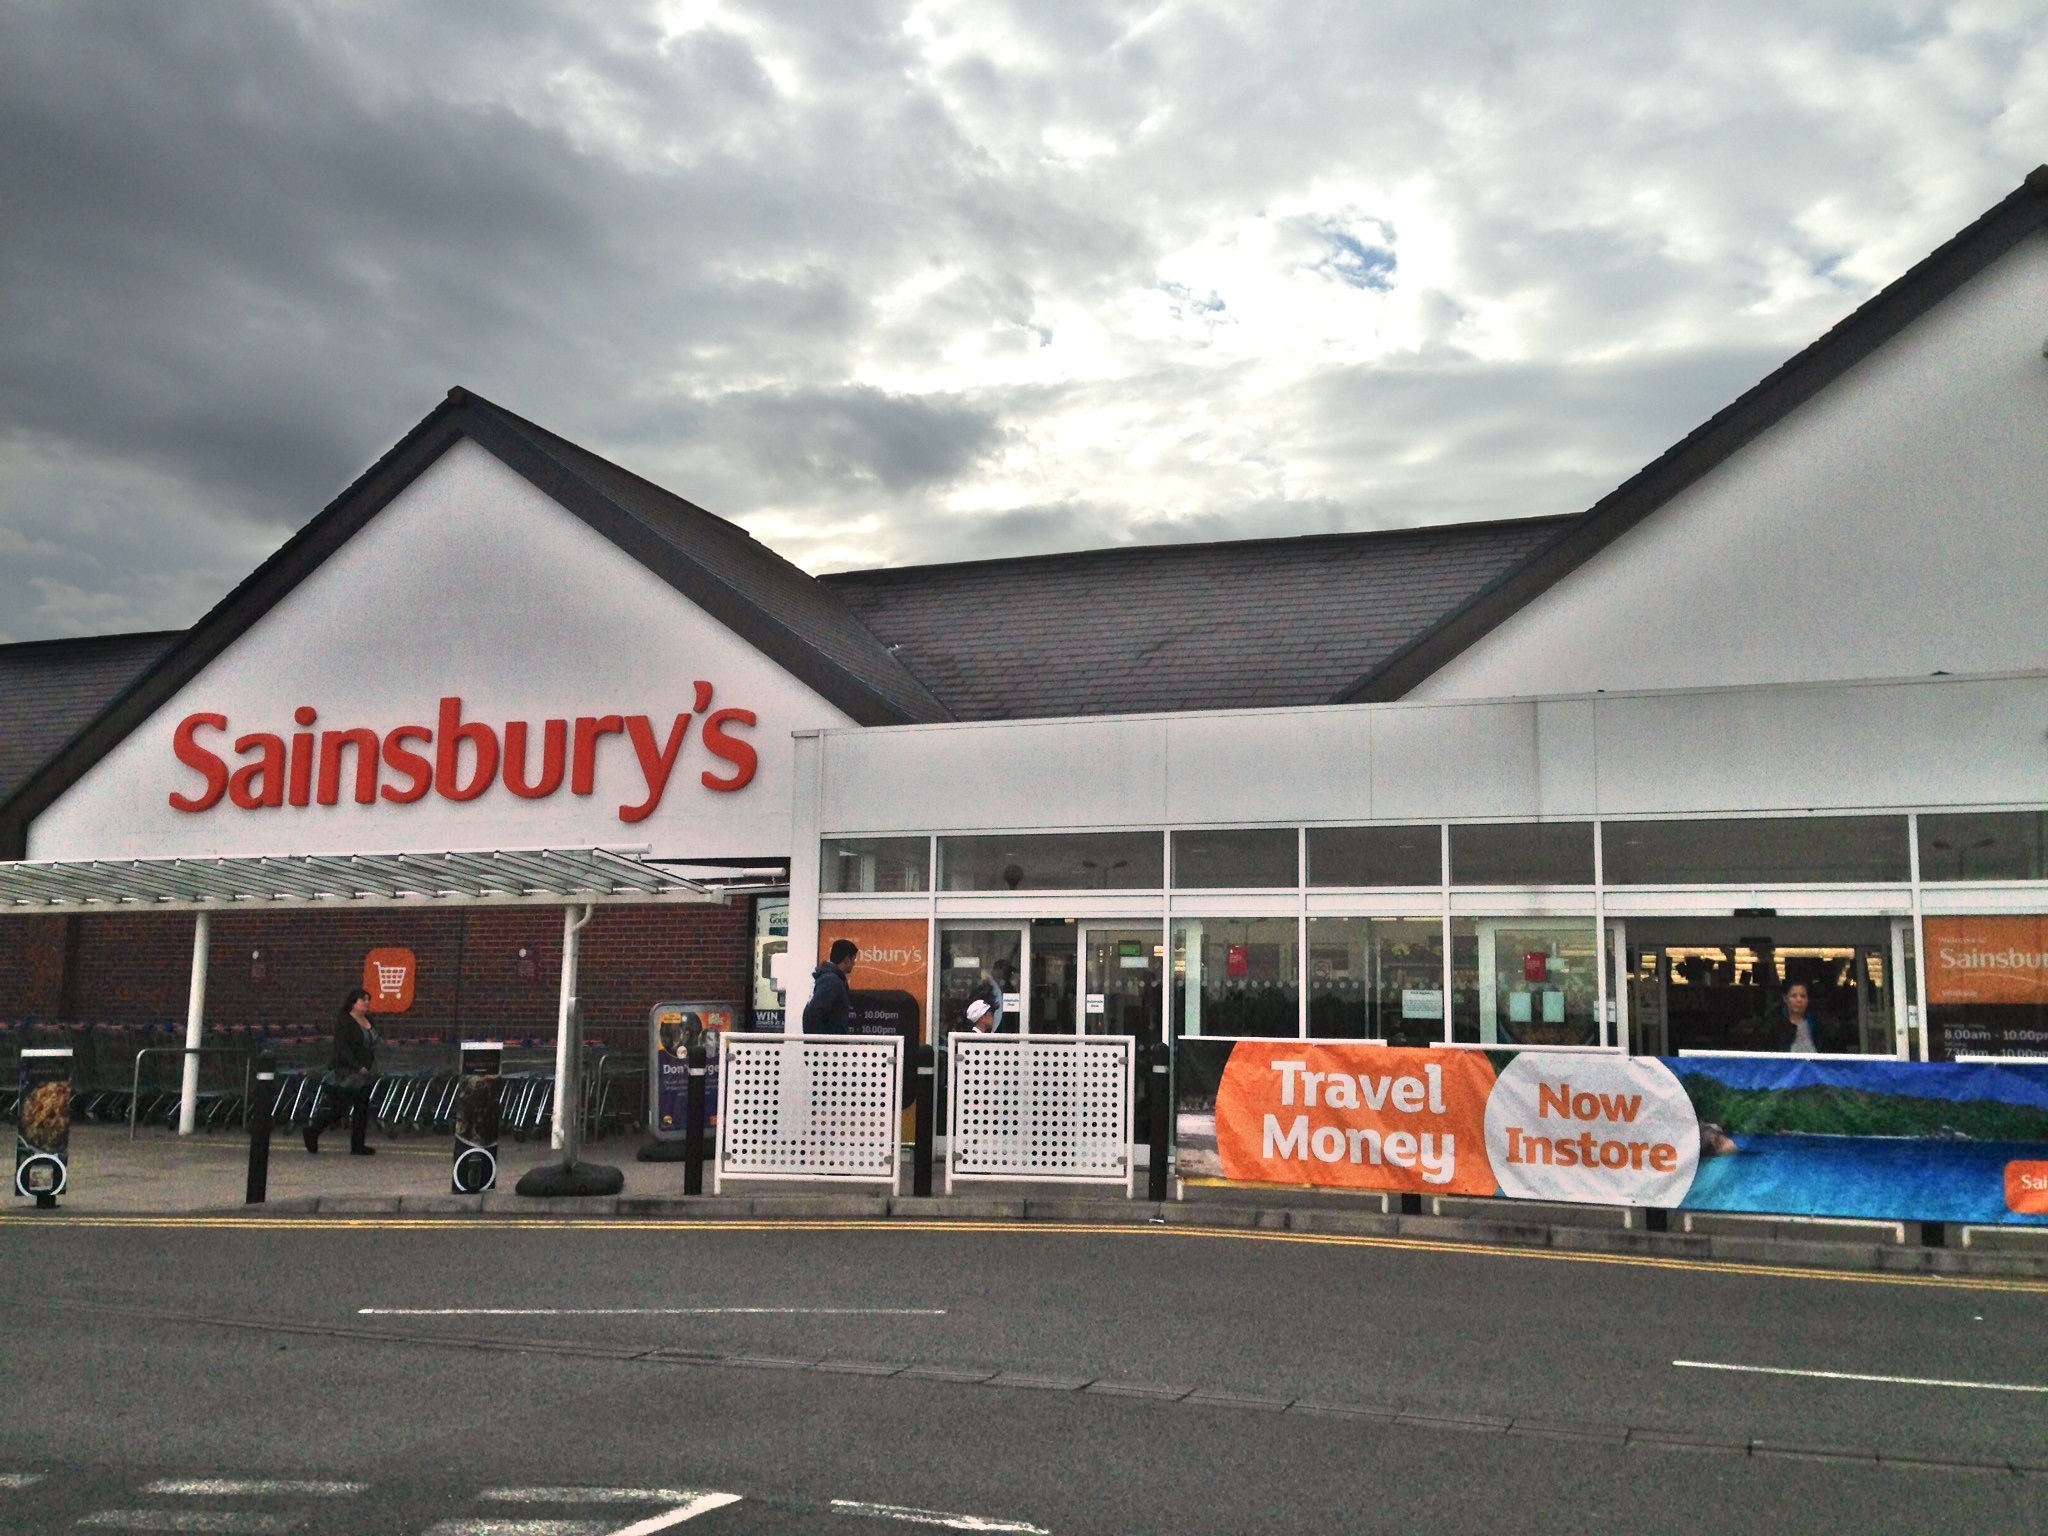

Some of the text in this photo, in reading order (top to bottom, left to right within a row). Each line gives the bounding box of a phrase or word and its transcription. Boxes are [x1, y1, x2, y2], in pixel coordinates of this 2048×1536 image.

[169, 680, 757, 822] Sainsbury's
[830, 945, 922, 966] nsbury's
[756, 1011, 778, 1021] WIN
[862, 1025, 897, 1035] 10.00pm
[864, 1010, 899, 1020] 10.00pm
[1944, 1029, 1991, 1040] 8.00am
[1271, 1060, 1446, 1115] Travel
[1539, 1082, 1642, 1123] Now
[1262, 1113, 1456, 1185] Money
[1505, 1127, 1678, 1173] Instore
